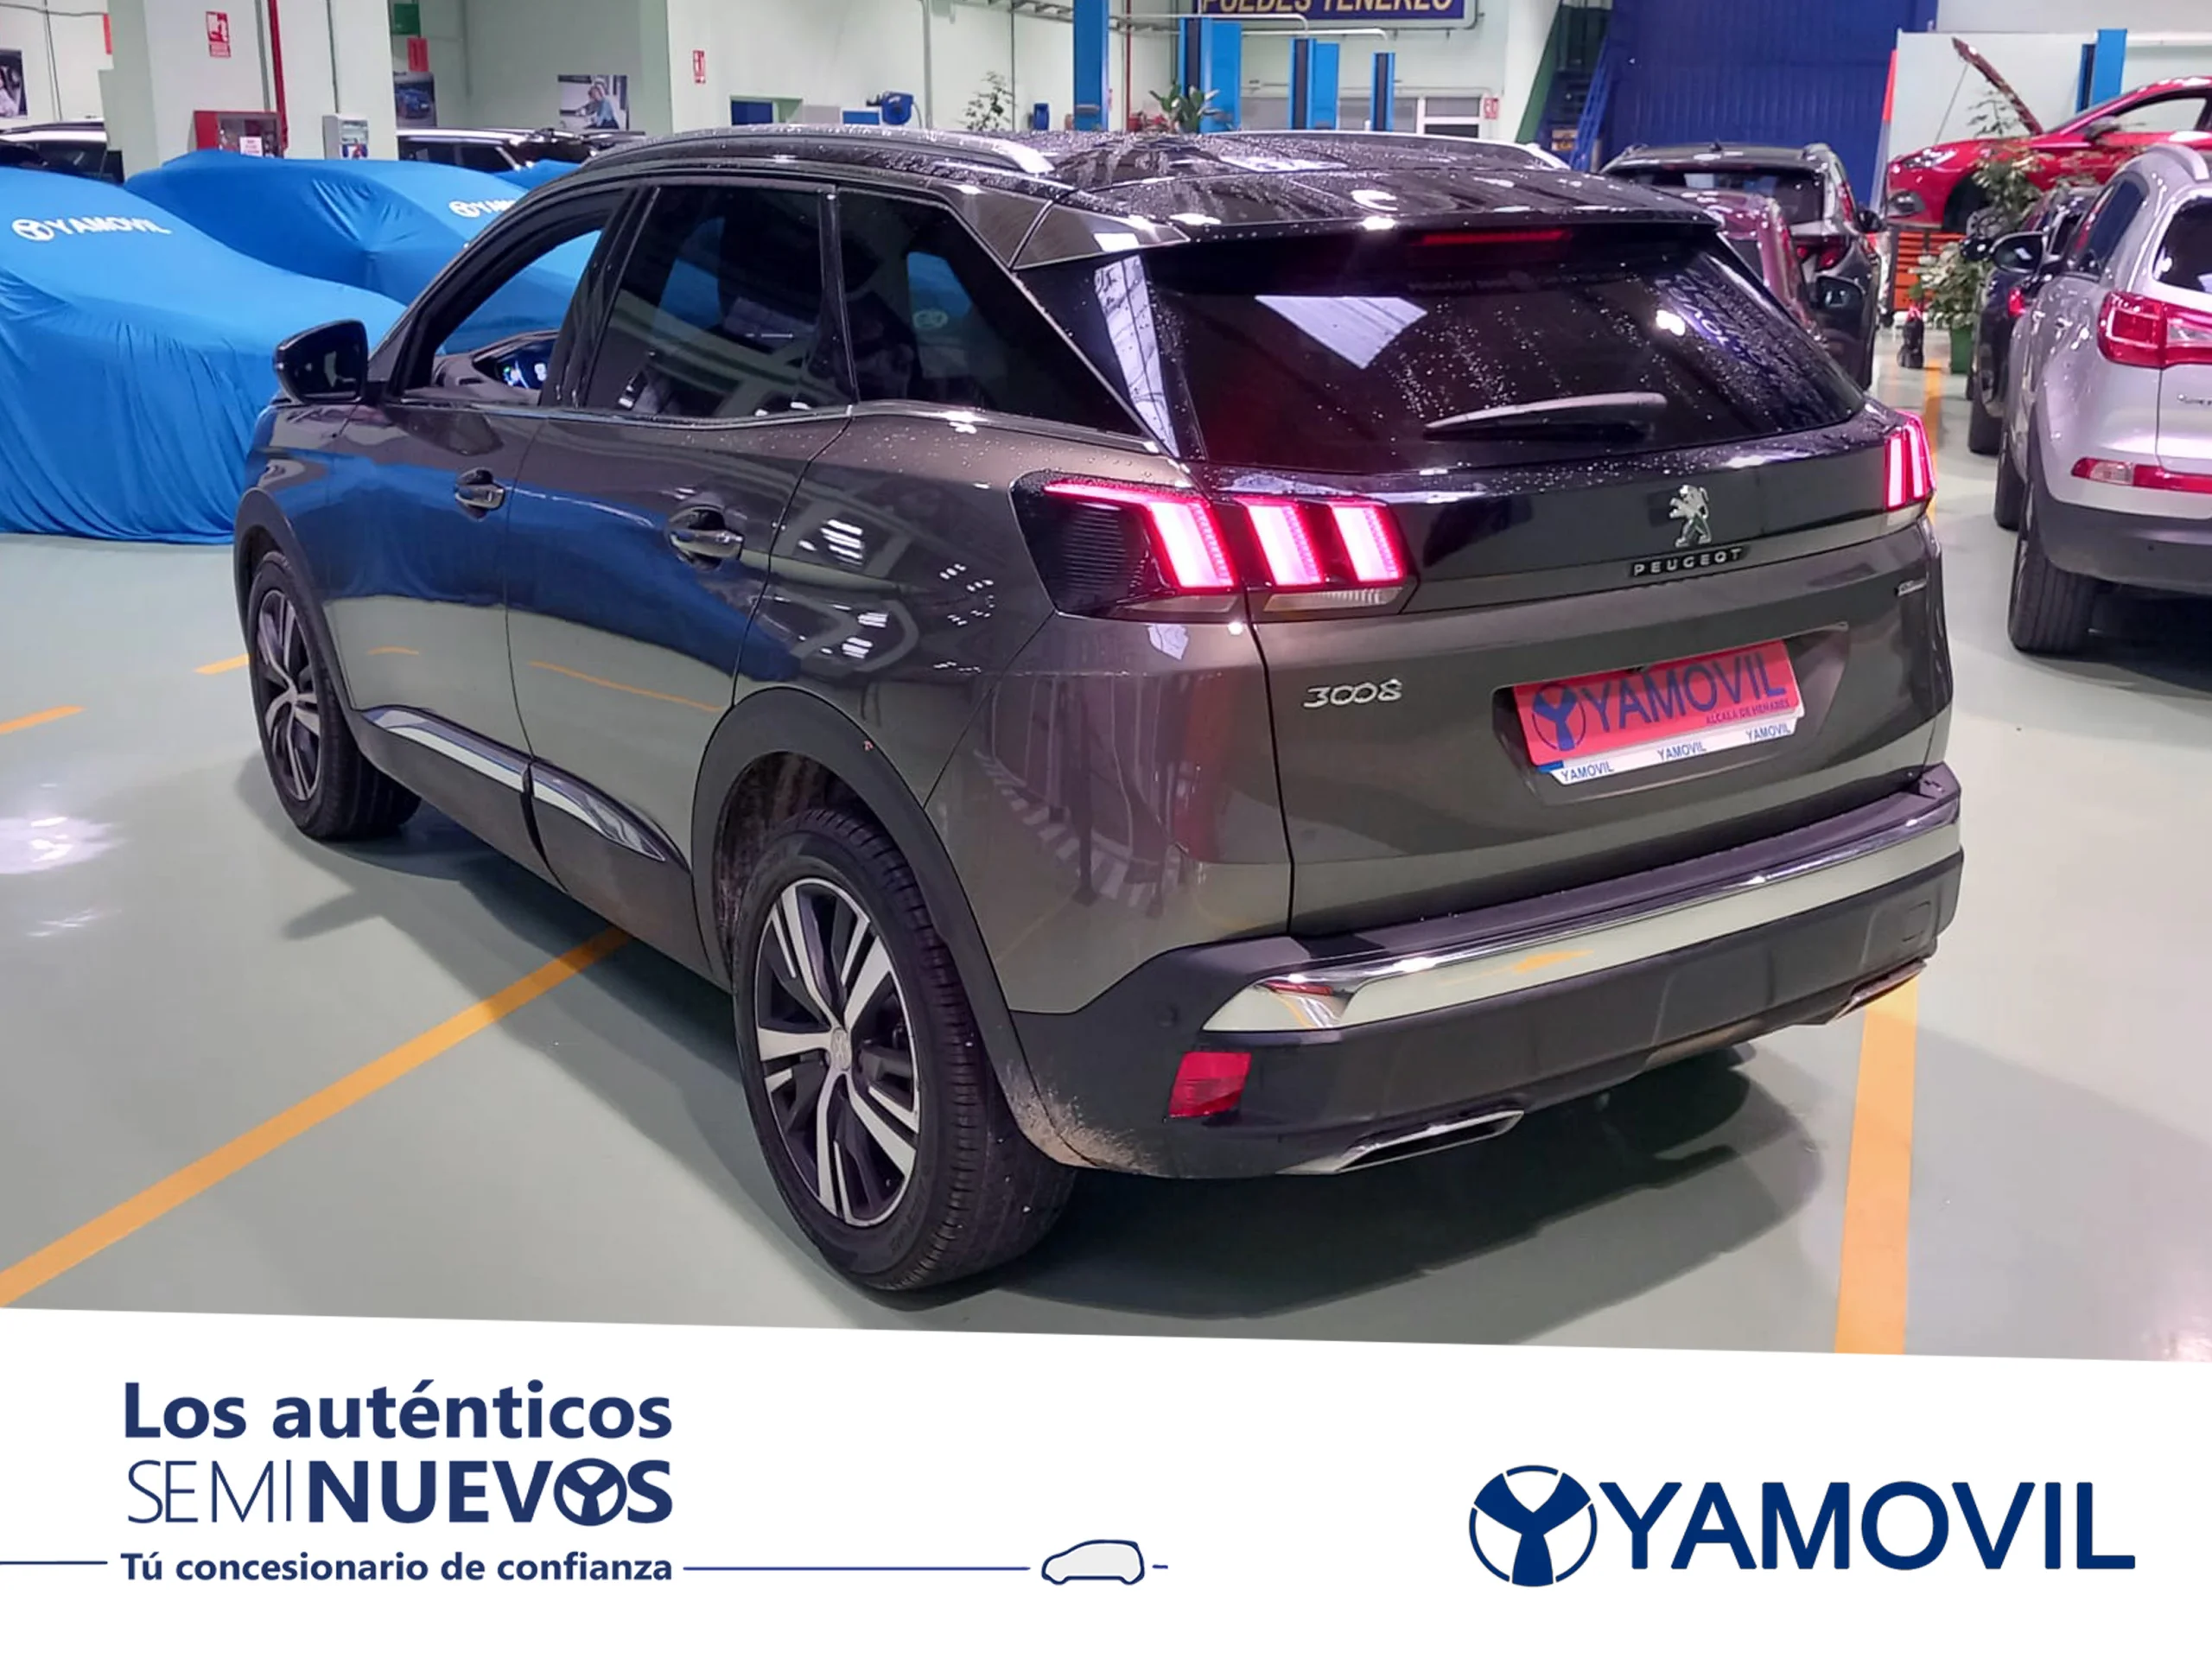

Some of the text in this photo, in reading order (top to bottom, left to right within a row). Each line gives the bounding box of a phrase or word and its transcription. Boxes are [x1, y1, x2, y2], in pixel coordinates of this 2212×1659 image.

[44, 217, 172, 235] YAMOVIL
[1633, 548, 1743, 576] PEUGEOT
[1303, 678, 1402, 708] 3008
[1580, 652, 1786, 732] YAMOVIL
[1745, 723, 1791, 741] YAMOVIL
[1657, 741, 1707, 761] YAMOVIL
[1560, 760, 1614, 782] YAMOVIL
